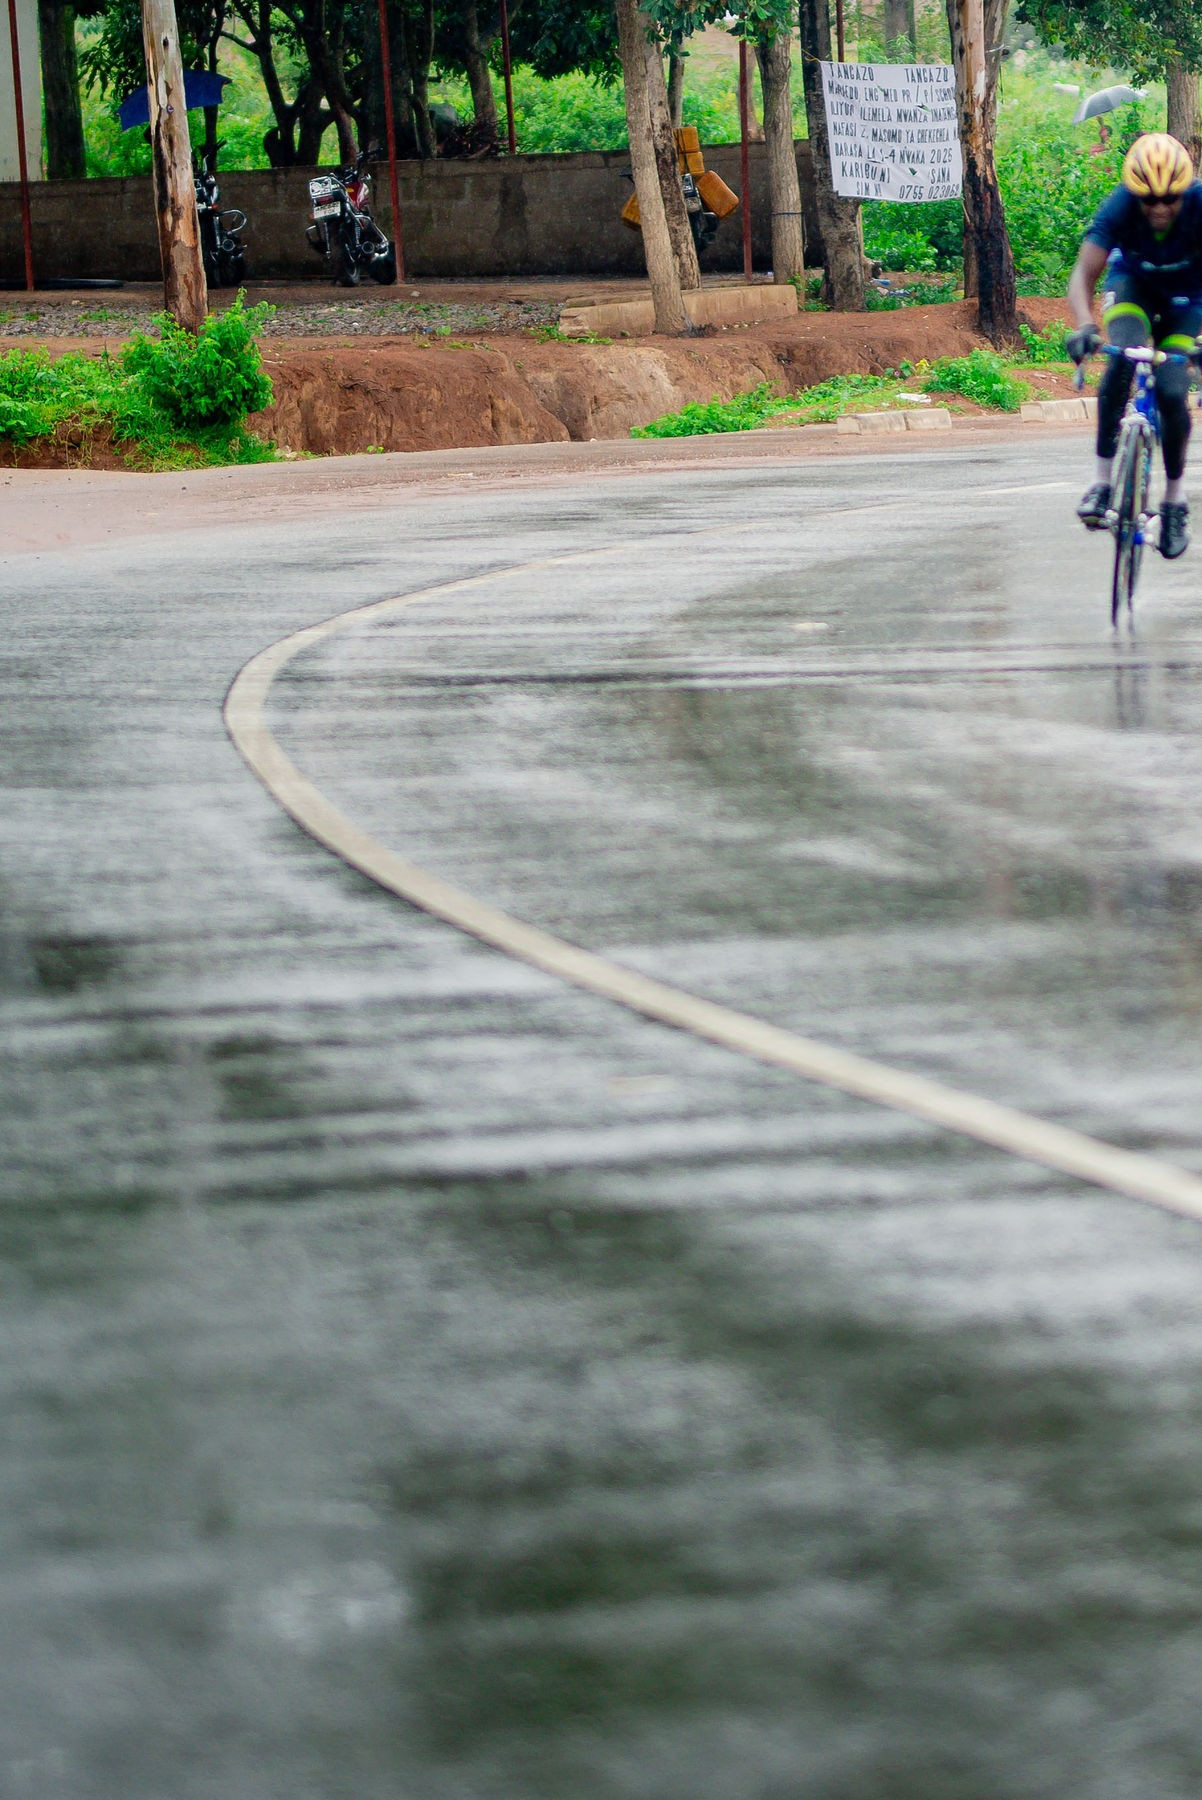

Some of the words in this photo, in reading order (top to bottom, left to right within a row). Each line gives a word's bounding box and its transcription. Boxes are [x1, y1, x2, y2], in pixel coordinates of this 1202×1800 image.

[828, 63, 875, 81] TANGAZO
[904, 67, 948, 83] TANGAZO
[860, 106, 892, 122] ILEMELA
[896, 108, 928, 122] MWANZA
[832, 121, 857, 137] NAFASI
[871, 127, 902, 144] MASOMO
[905, 129, 915, 144] YA
[834, 142, 863, 158] DARASA
[856, 181, 870, 196] SIM
[899, 184, 924, 200] 0755
